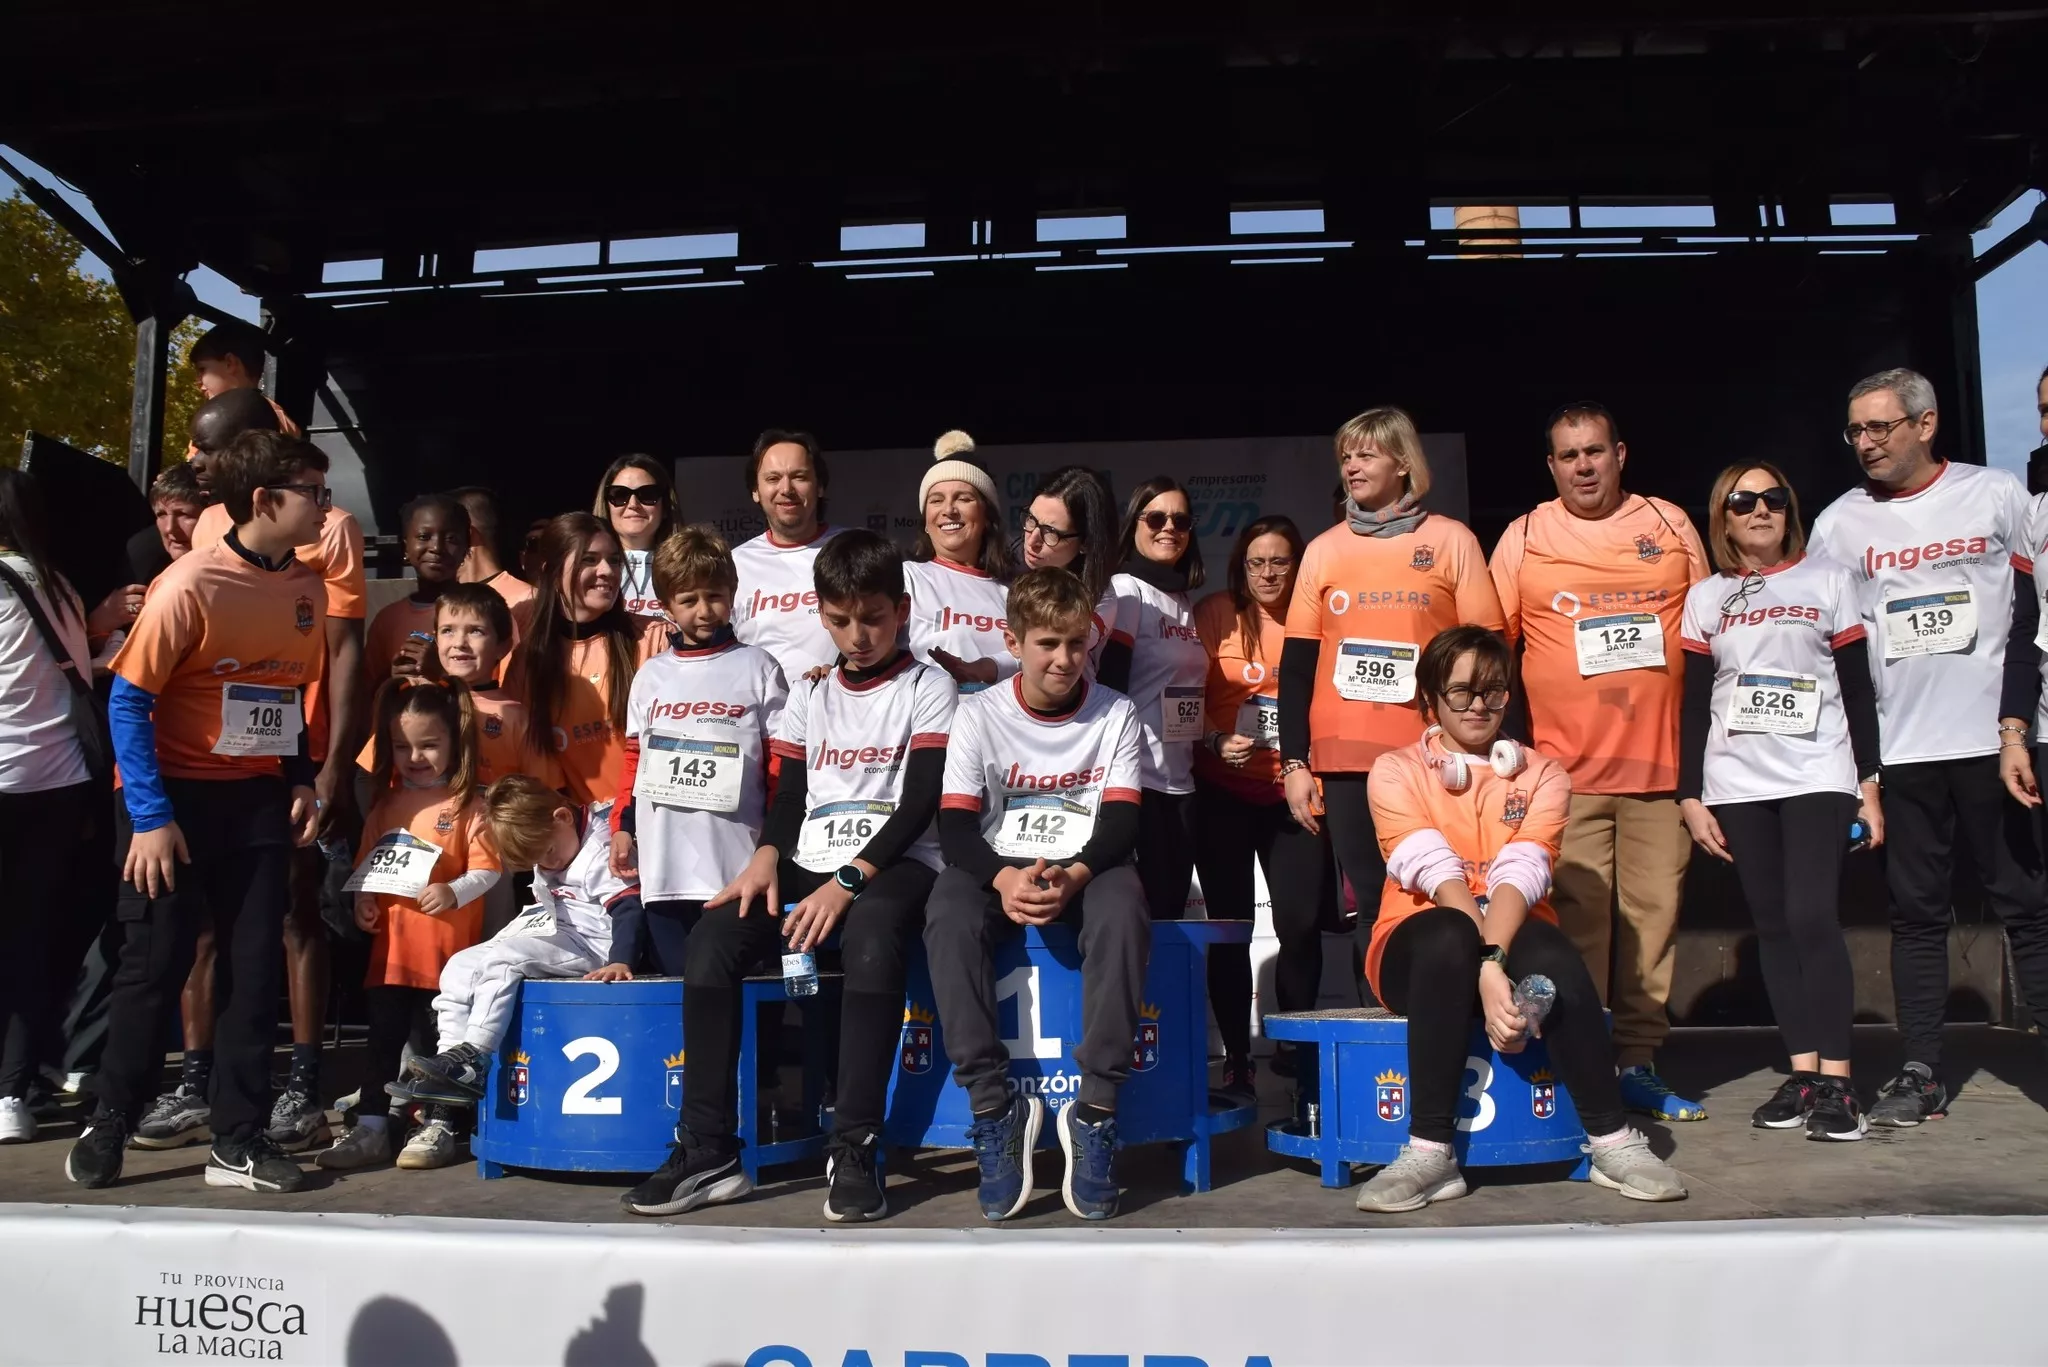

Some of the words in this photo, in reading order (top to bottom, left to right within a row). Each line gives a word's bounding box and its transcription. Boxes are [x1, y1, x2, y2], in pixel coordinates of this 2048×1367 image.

[1866, 536, 1986, 580] Ingesa
[1358, 590, 1432, 605] ESPIAS
[1907, 609, 1953, 630] 139
[1599, 626, 1643, 645] 122
[1606, 642, 1635, 652] DAVID
[1355, 660, 1396, 679] 596
[1360, 676, 1399, 687] CARMEN
[1178, 701, 1200, 717] 625
[1751, 690, 1796, 710] 626
[249, 706, 282, 728] 108
[650, 698, 747, 726] Ingesa
[1740, 707, 1771, 716] MARIA
[1773, 709, 1804, 719] PILAR
[245, 726, 282, 737] MARCOS
[814, 738, 907, 770] Ingesa
[668, 756, 717, 779] 143
[1007, 762, 1106, 792] Ingesa
[670, 776, 708, 788] PABLO
[823, 818, 873, 840] 146
[1017, 812, 1067, 836] 142
[827, 838, 861, 848] HUGO
[1015, 833, 1057, 844] MATEO
[370, 849, 412, 868] 594
[370, 866, 399, 876] MARIA
[995, 966, 1062, 1060] 1
[562, 1036, 622, 1115] 2
[1453, 1055, 1496, 1133] 3
